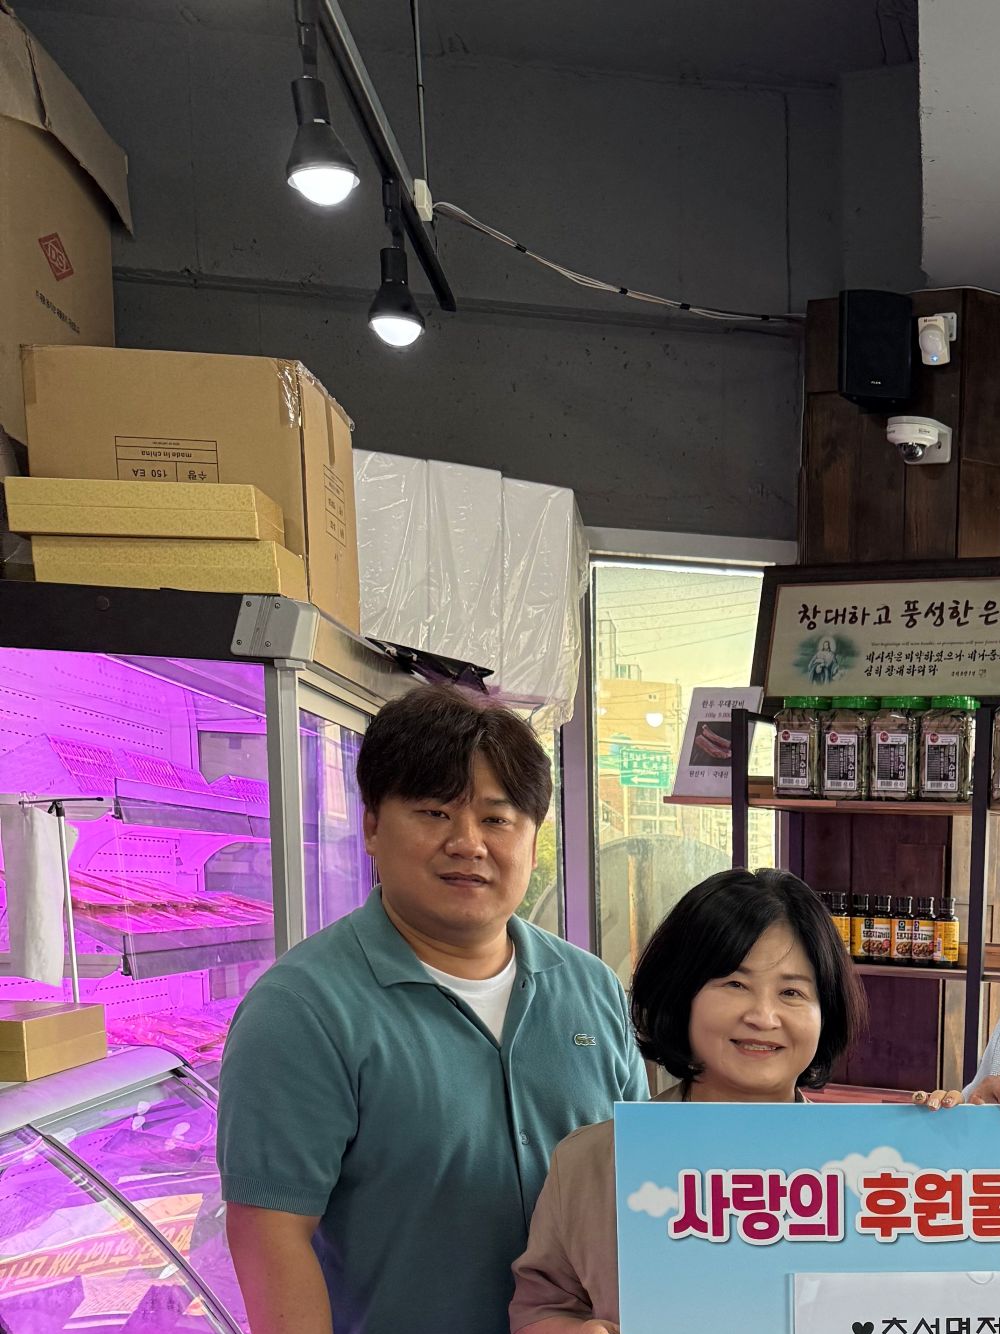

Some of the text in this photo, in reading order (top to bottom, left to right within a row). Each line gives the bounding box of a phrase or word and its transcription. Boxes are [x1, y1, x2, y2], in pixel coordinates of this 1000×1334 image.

[141, 450, 162, 458] china
[172, 451, 192, 459] made
[132, 468, 146, 477] EA
[151, 469, 167, 478] 150
[798, 603, 892, 631] 창대하고
[900, 599, 974, 629] 풍성한
[670, 1168, 845, 1244] 사랑의
